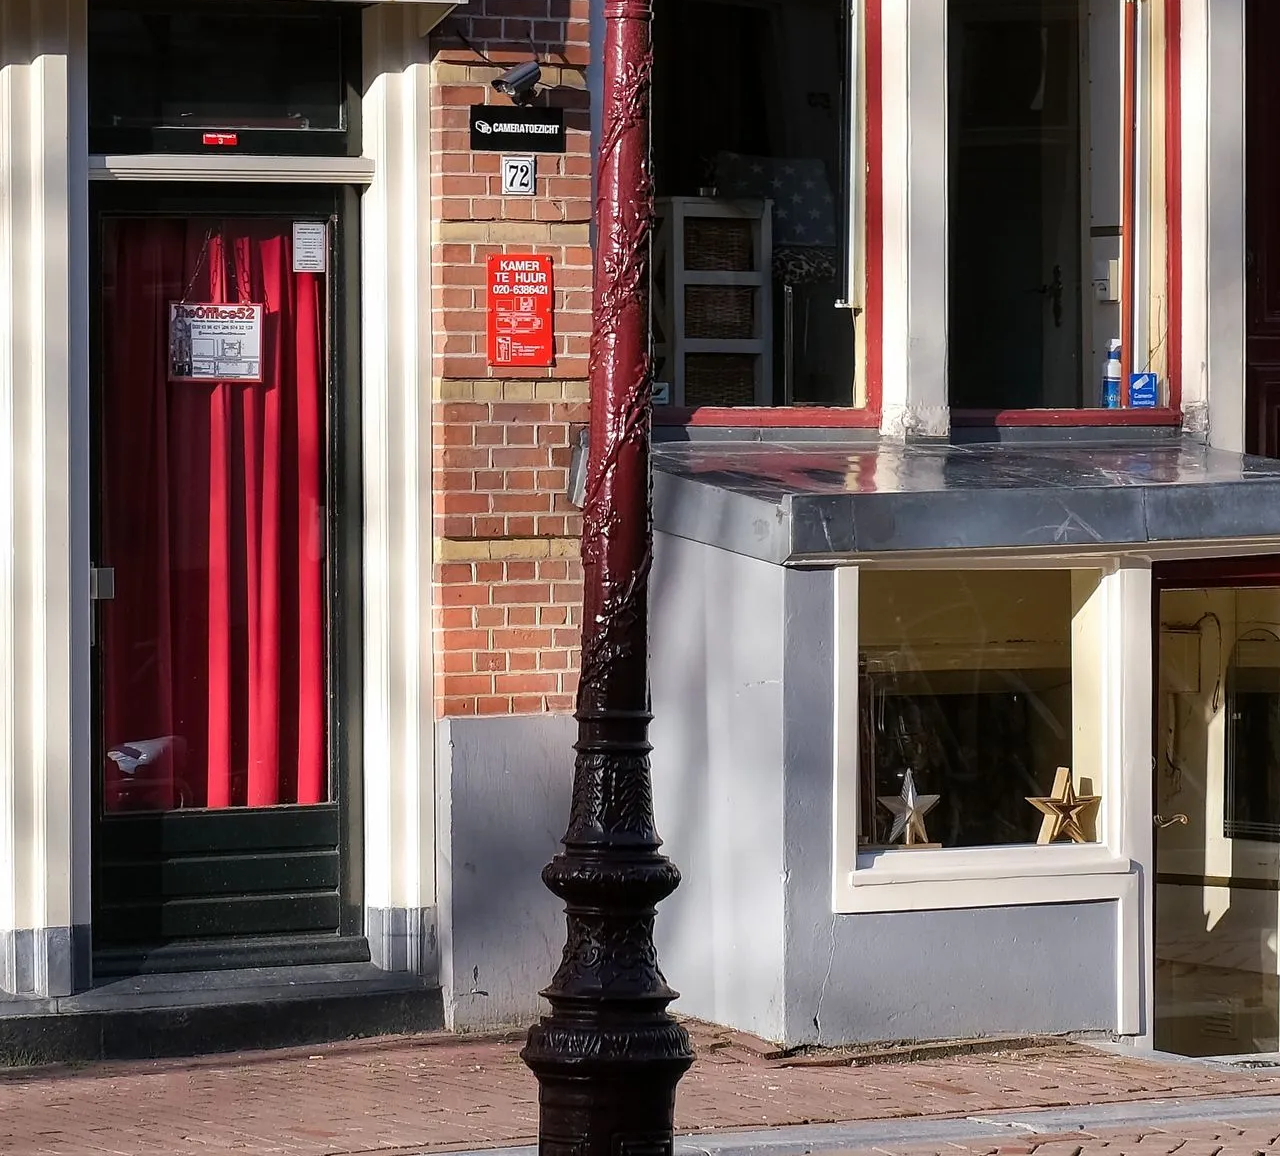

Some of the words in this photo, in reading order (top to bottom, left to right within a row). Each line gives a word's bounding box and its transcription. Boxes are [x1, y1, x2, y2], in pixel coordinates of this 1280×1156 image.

[492, 123, 560, 135] CAMERATOEZICHT
[508, 164, 530, 188] 72
[500, 260, 540, 272] KAMER
[495, 272, 509, 283] TE
[515, 272, 546, 283] HUUR
[493, 285, 548, 295] 020-6386421
